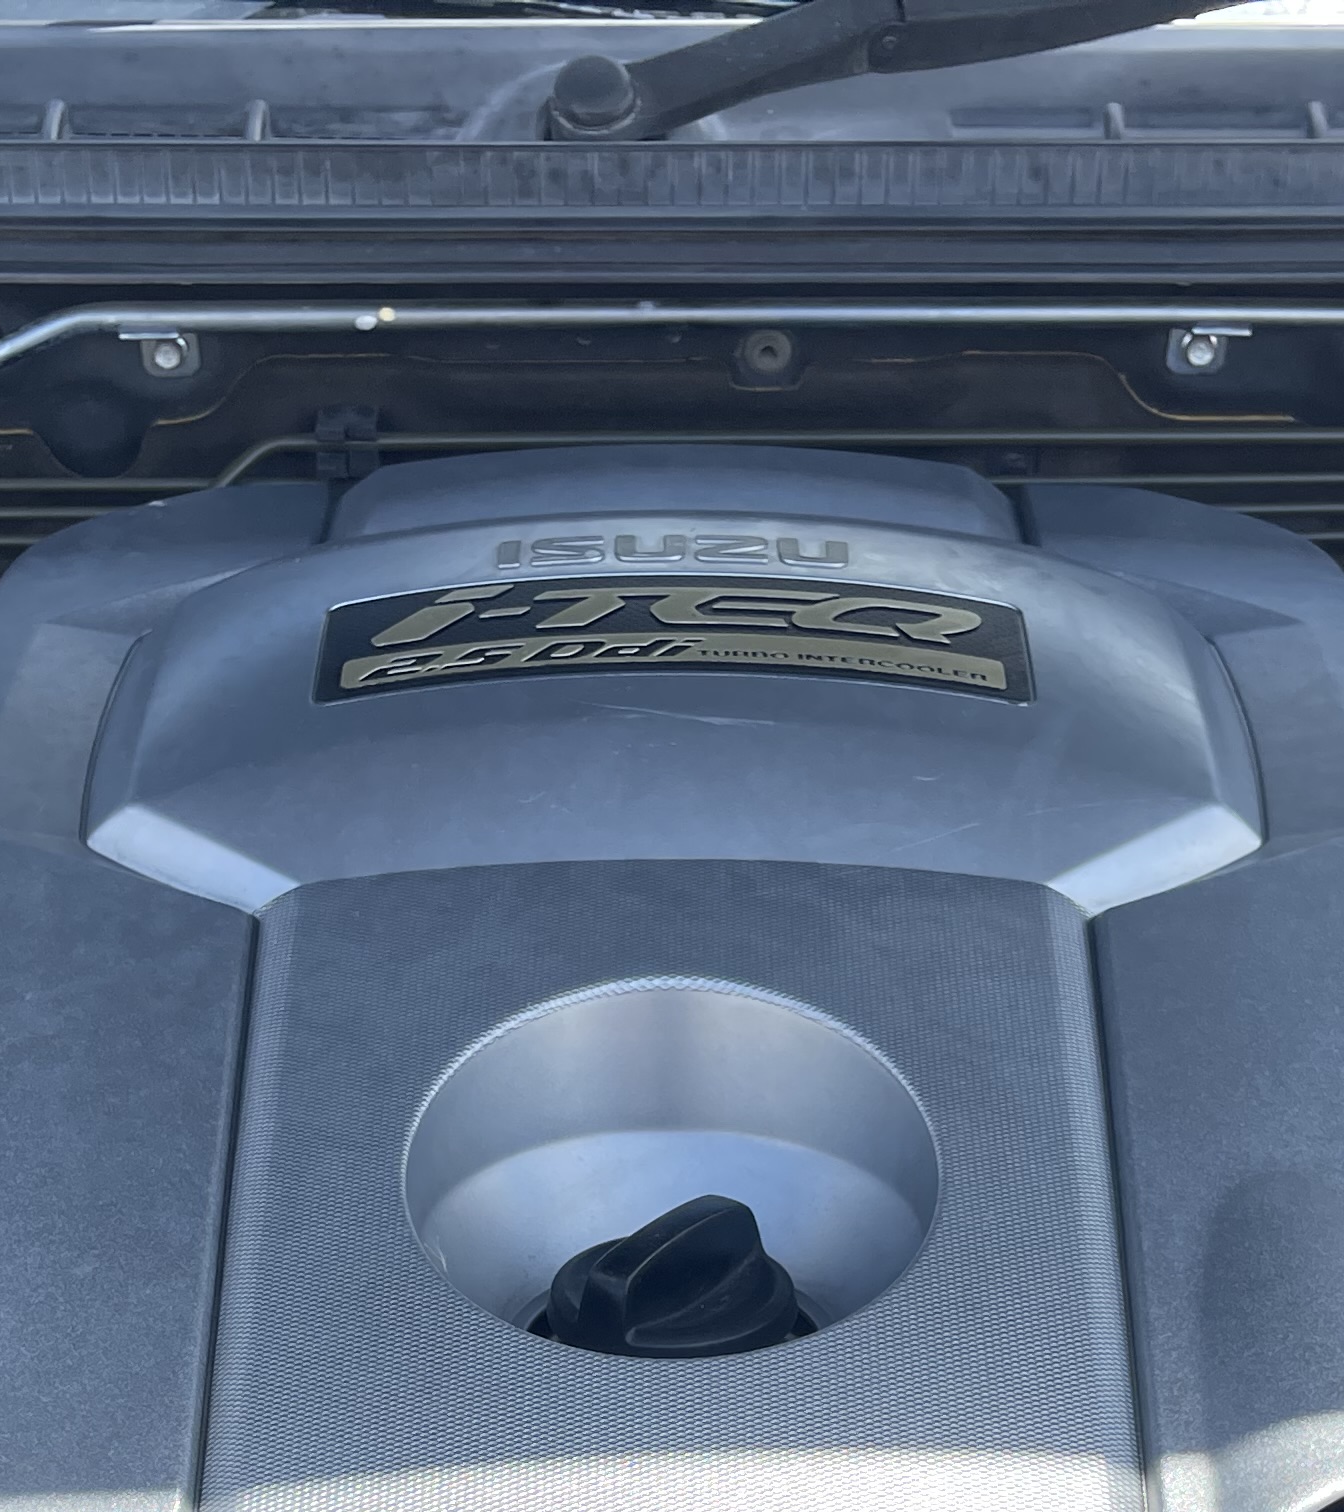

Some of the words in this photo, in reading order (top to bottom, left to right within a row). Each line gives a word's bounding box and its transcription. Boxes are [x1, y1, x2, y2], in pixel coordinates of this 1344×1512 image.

[496, 533, 849, 570] ISUZU
[696, 649, 790, 661] TURBO
[796, 653, 988, 682] INTERCOOLER
